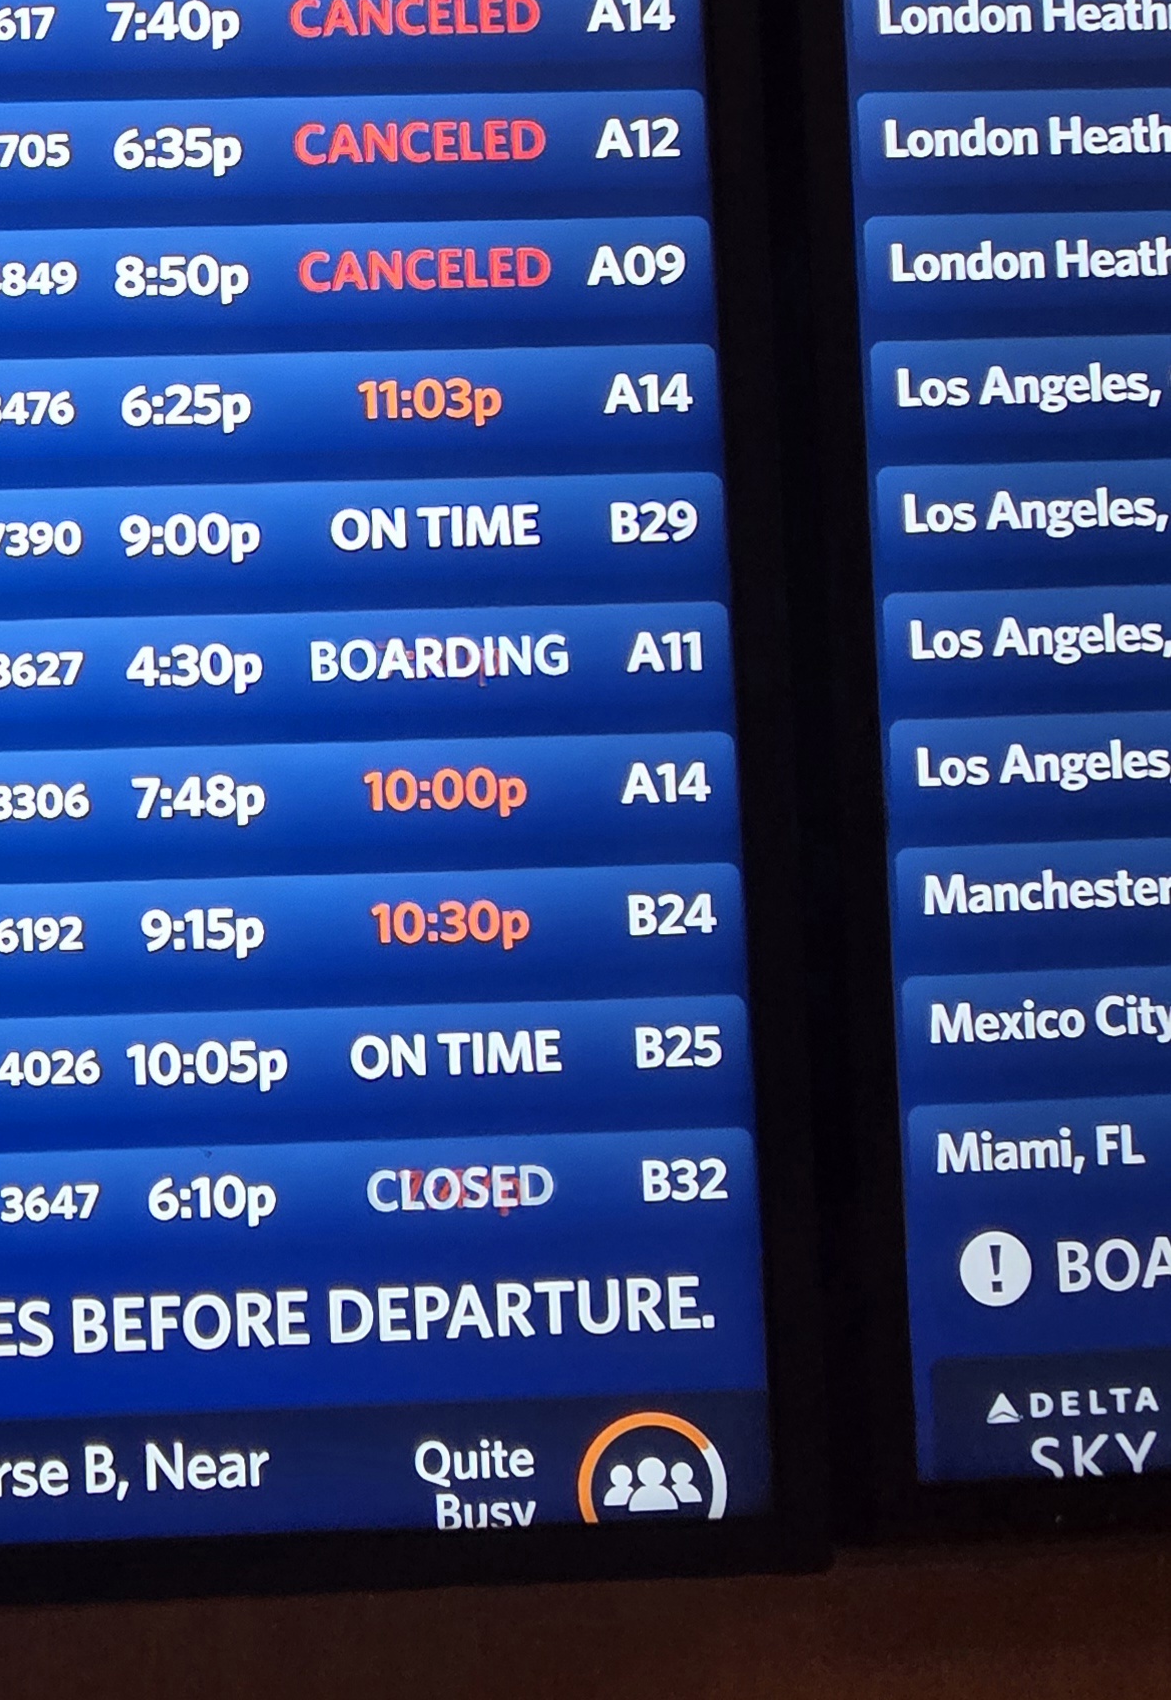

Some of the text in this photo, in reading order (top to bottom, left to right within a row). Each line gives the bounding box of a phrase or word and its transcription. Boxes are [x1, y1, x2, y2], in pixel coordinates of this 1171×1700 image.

[896, 361, 1162, 413] Los Angeles,
[930, 998, 1086, 1044] Mexico
[936, 1124, 1146, 1175] Miami, FL
[0, 1183, 100, 1223] 3647
[148, 1174, 277, 1227] 6:10p
[366, 1164, 555, 1213] CLOSED
[641, 1157, 729, 1202] B32
[72, 1289, 311, 1354] BEFORE
[328, 1275, 715, 1344] DEPARTURE.
[1029, 1386, 1159, 1418] DELTA
[84, 1444, 129, 1501] B,
[145, 1441, 270, 1491] Near
[414, 1438, 535, 1488] Quite
